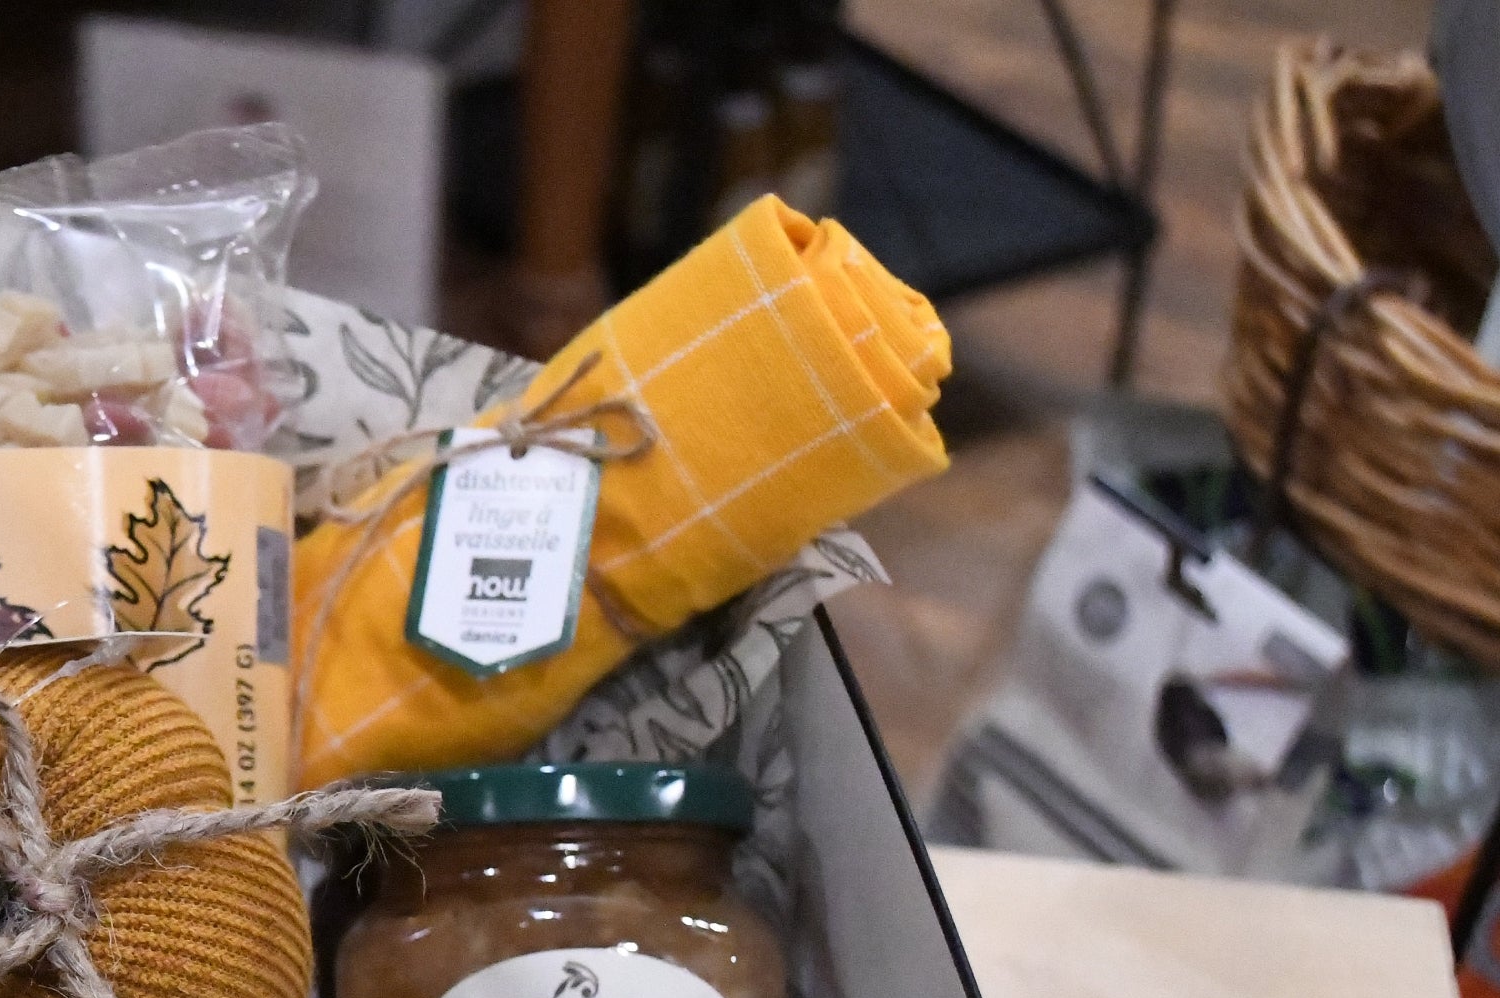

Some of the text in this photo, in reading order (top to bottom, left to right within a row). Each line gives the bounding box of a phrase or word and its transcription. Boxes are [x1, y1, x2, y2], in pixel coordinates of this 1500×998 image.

[467, 573, 531, 600] now
[235, 642, 255, 670] G)
[237, 740, 257, 771] OZ
